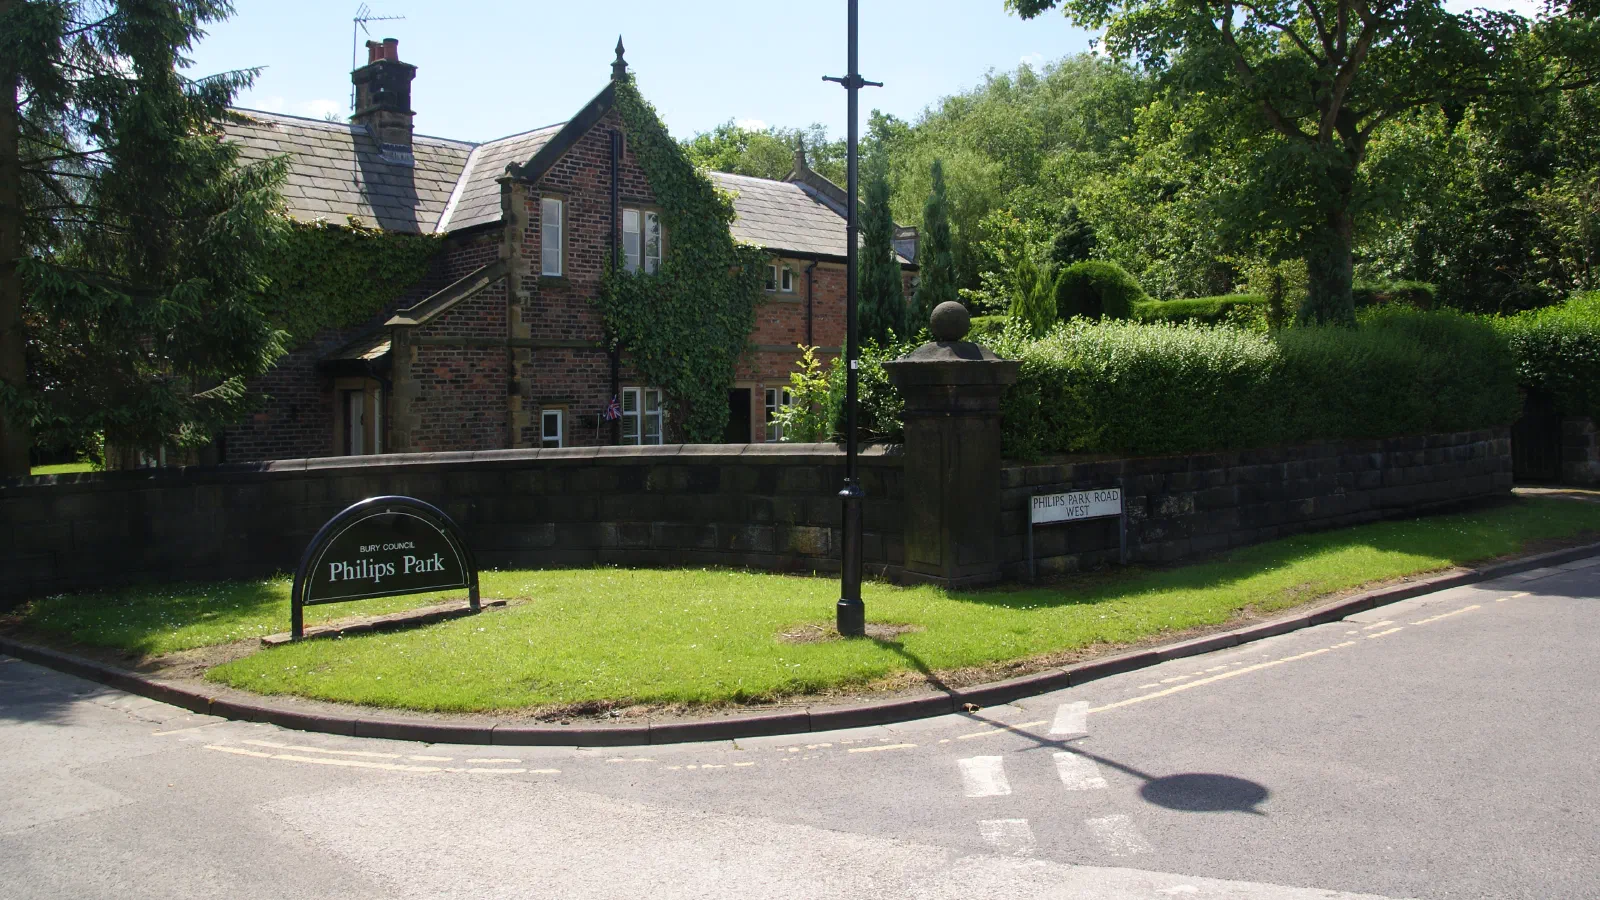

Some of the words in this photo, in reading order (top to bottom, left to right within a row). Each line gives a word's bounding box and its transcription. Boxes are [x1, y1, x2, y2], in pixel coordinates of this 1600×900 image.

[1033, 495, 1065, 509] PHILIPS
[1068, 493, 1091, 505] PARK
[1094, 490, 1119, 503] ROAD
[1065, 505, 1090, 517] WEST
[360, 544, 380, 553] BURY
[383, 541, 415, 551] COUNCIL
[329, 558, 395, 583] Philips
[403, 552, 445, 574] Park
